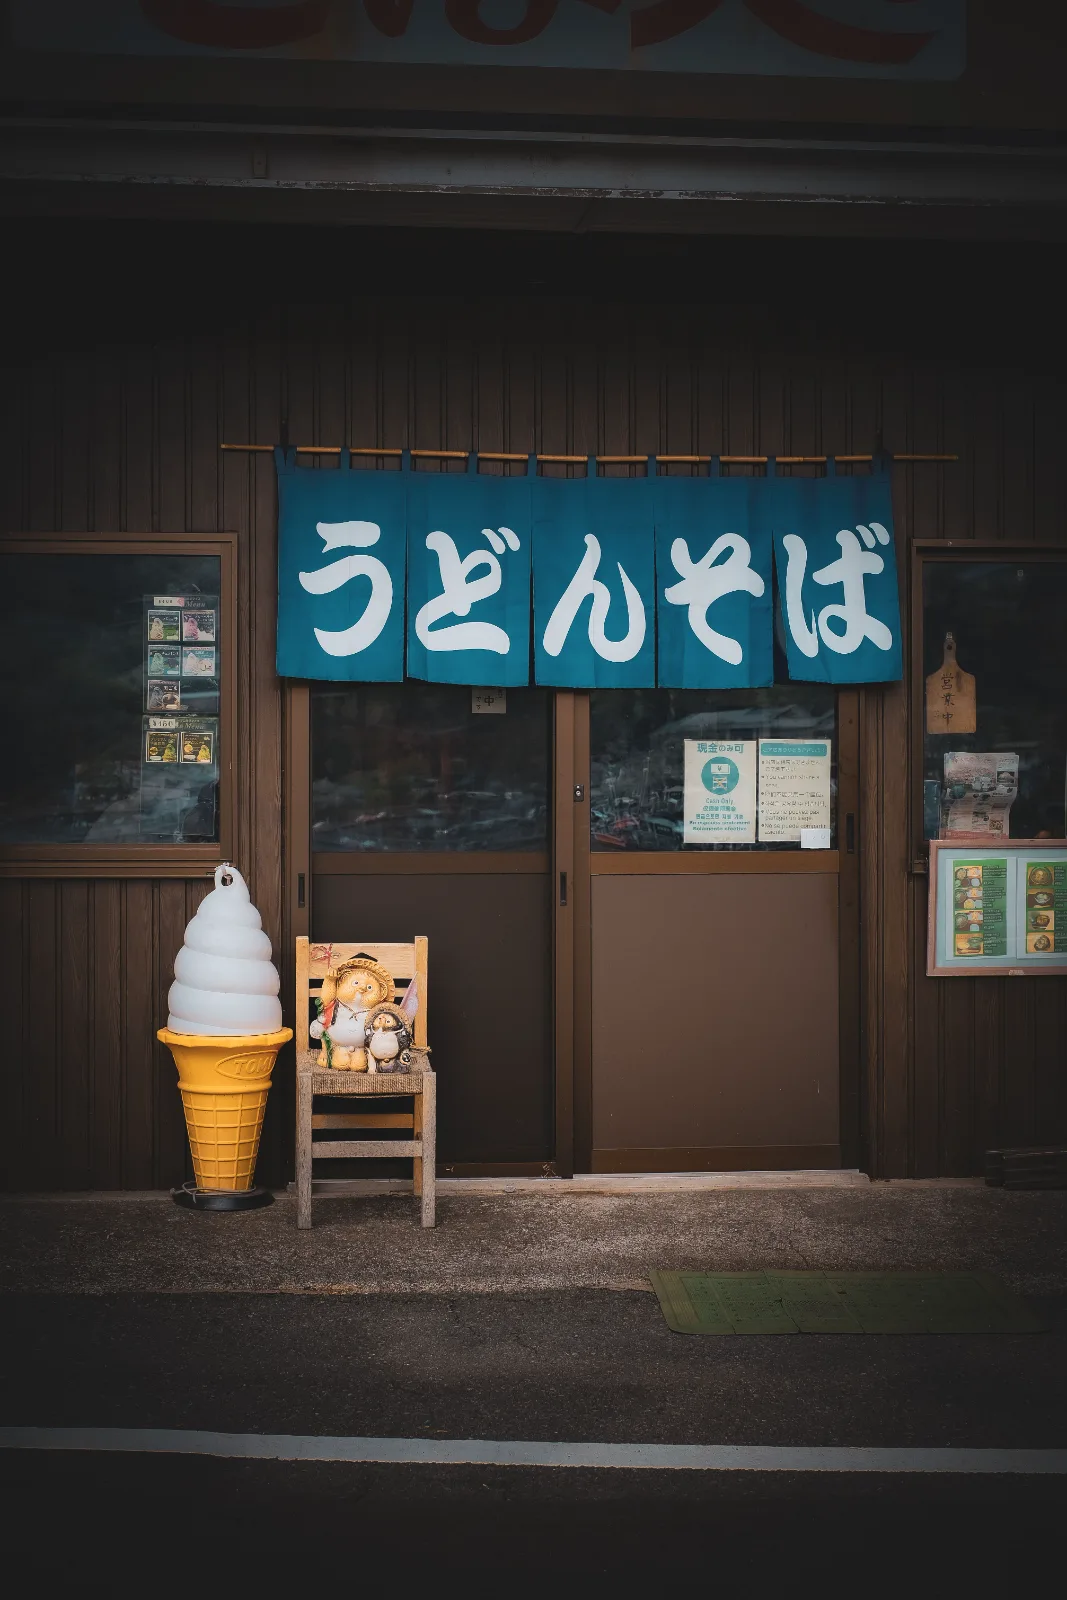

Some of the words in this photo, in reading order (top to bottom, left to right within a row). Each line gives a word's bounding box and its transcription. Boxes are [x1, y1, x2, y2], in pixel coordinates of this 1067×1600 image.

[299, 520, 893, 666] うどんそば
[697, 742, 744, 754] 現金のみ可
[720, 797, 734, 806] Only
